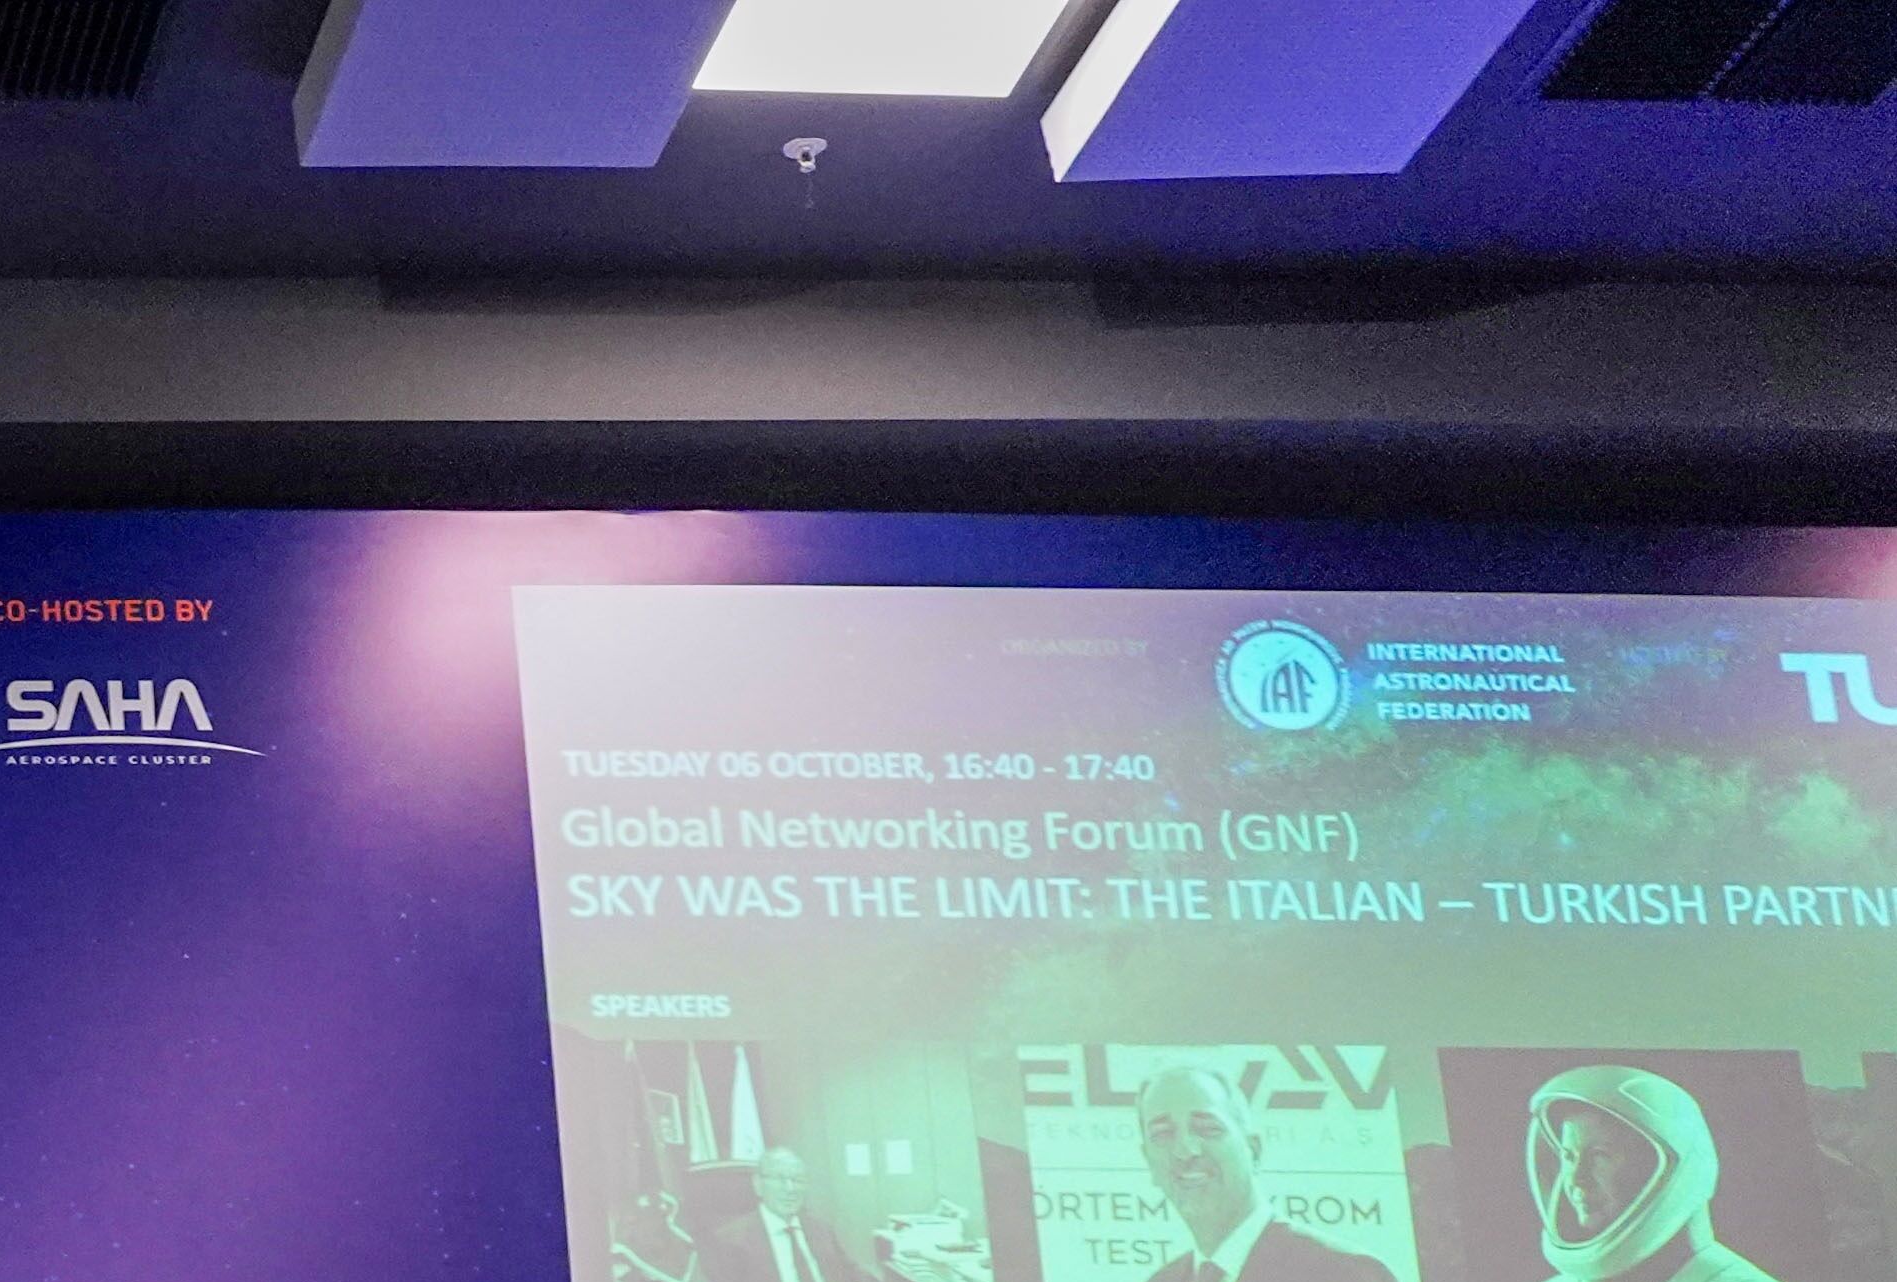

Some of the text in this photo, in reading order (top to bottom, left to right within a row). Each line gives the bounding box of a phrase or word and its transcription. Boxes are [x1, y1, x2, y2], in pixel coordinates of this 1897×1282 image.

[175, 599, 213, 622] BY
[1367, 643, 1565, 663] INTERNATIONAL
[1373, 672, 1576, 693] ASTRONAUTICAL
[6, 679, 213, 731] SAHA
[1377, 702, 1532, 722] FEDERATION
[5, 755, 212, 766] AEROSPACE CLUSTER
[562, 750, 1155, 784] TUESDAY 06 OCTOBER, 16:40 17:40
[561, 806, 1359, 861] Global Networking Forum (GNF)
[567, 874, 1707, 924] SKY WAS THE LIMIT: THE ITALIAN TURKISH
[591, 995, 730, 1018] SPEAKERS
[1085, 1238, 1173, 1266] TEST
